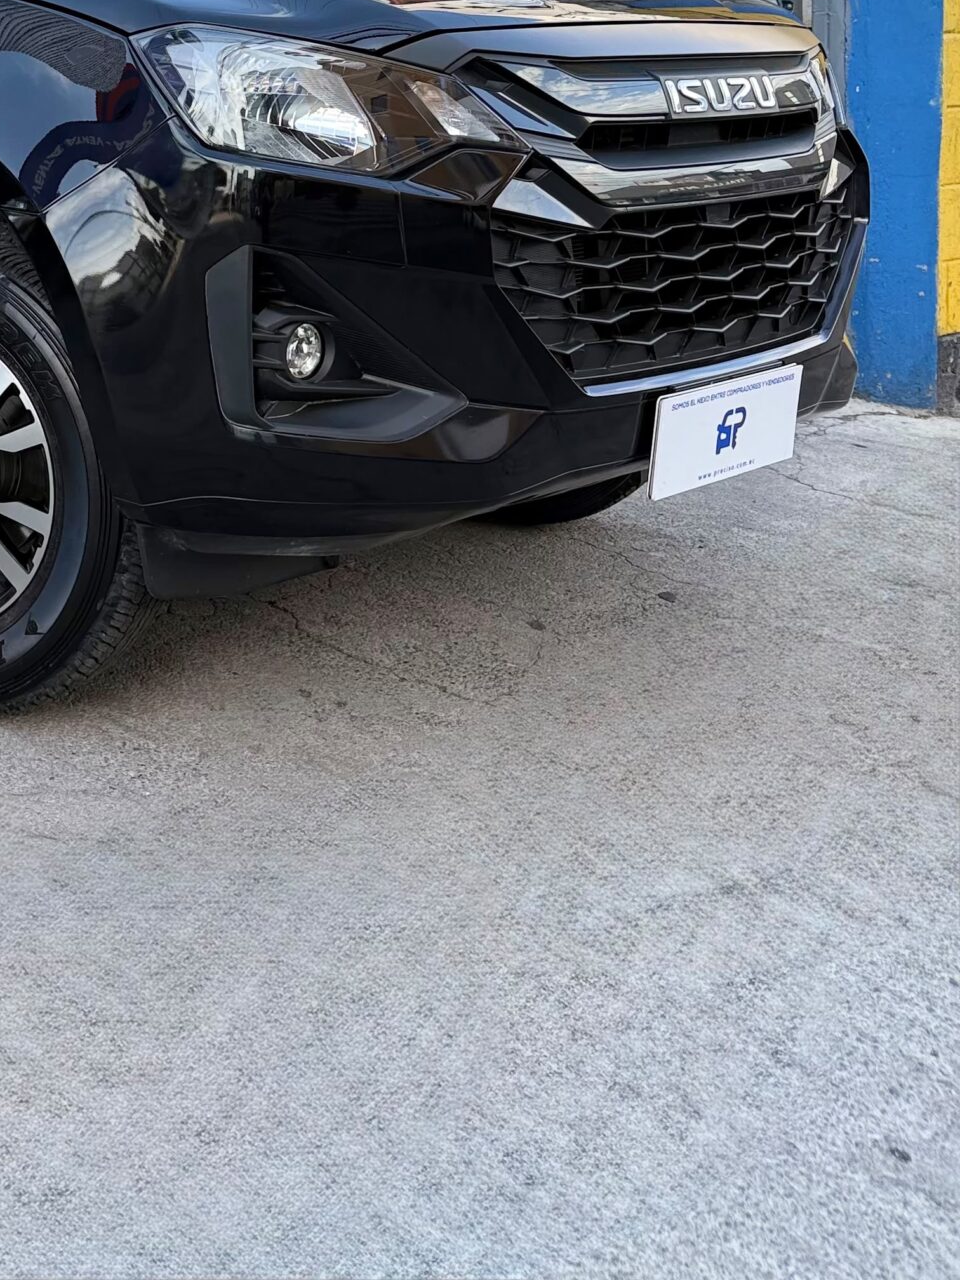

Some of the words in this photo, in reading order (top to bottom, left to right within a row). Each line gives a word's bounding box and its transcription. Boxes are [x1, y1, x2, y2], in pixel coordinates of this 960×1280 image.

[664, 75, 776, 114] ISUZU
[671, 400, 690, 412] SOMOS
[690, 399, 696, 407] EL
[710, 391, 726, 401] ENTRE
